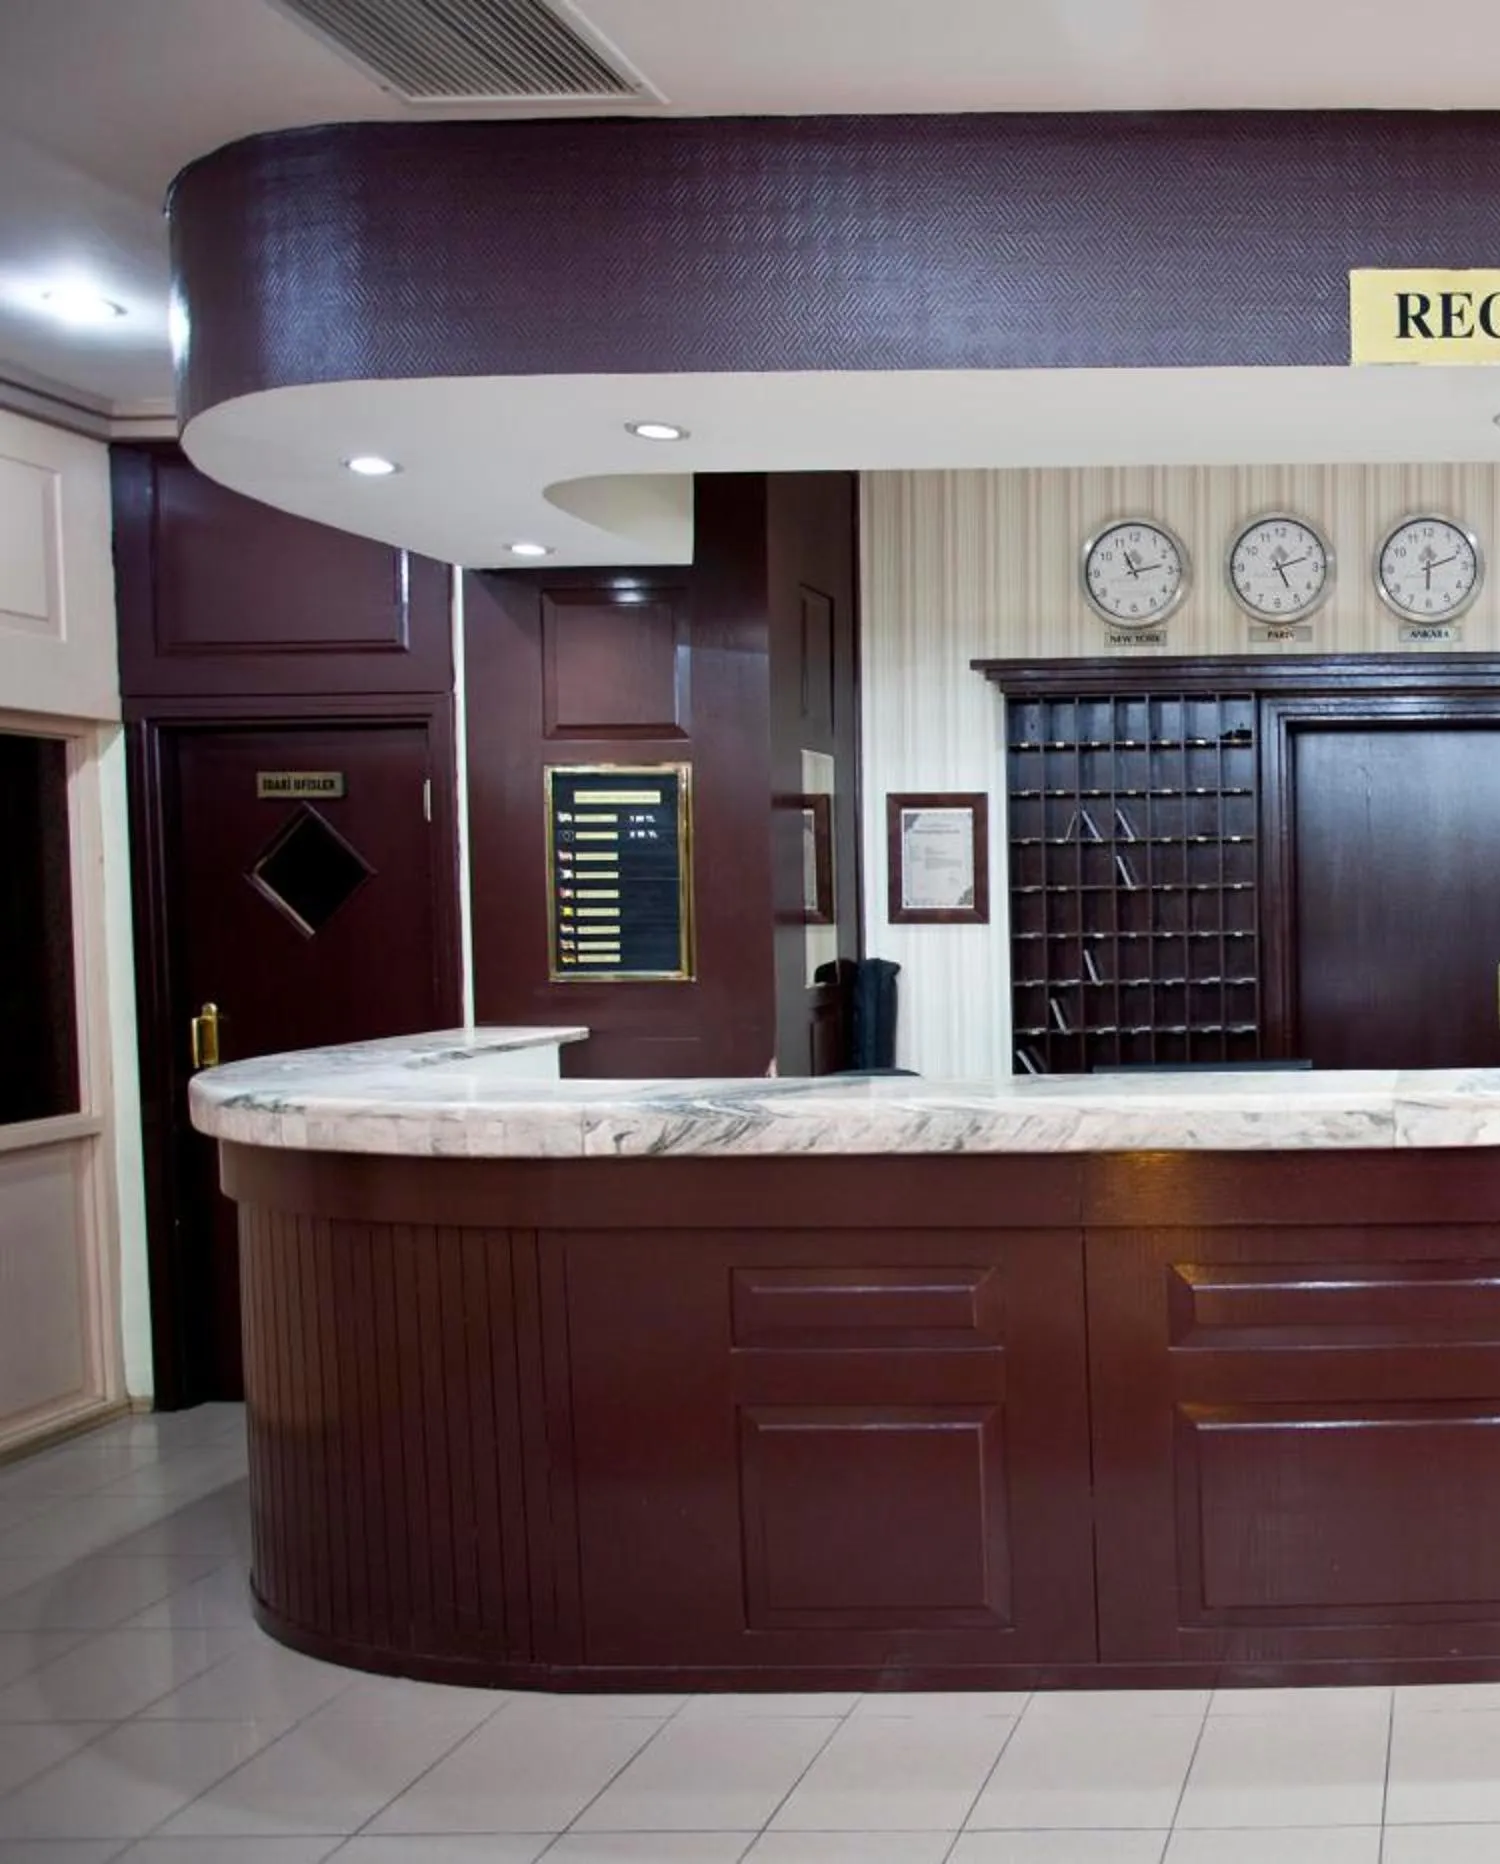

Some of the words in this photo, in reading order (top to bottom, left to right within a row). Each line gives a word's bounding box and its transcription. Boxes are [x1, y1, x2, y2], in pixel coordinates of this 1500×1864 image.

[1109, 634, 1133, 644] NEW
[1134, 634, 1161, 644] YORK
[1267, 630, 1295, 640] PARIS
